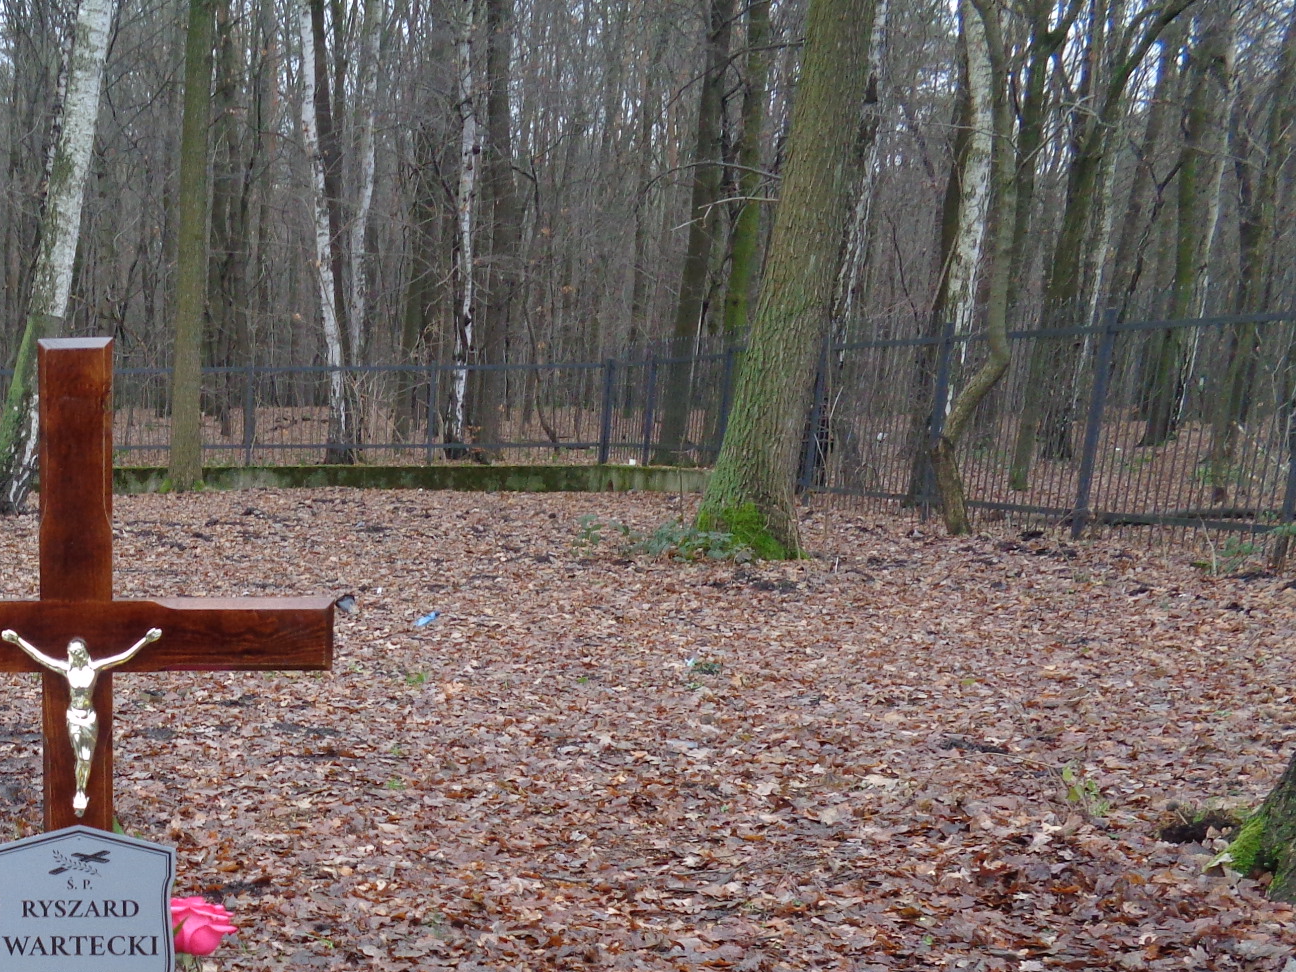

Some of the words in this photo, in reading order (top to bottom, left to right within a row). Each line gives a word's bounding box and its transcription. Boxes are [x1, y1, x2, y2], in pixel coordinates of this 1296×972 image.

[83, 879, 93, 890] P.
[21, 899, 140, 919] RYSZARD
[2, 935, 160, 957] WARTECKI
